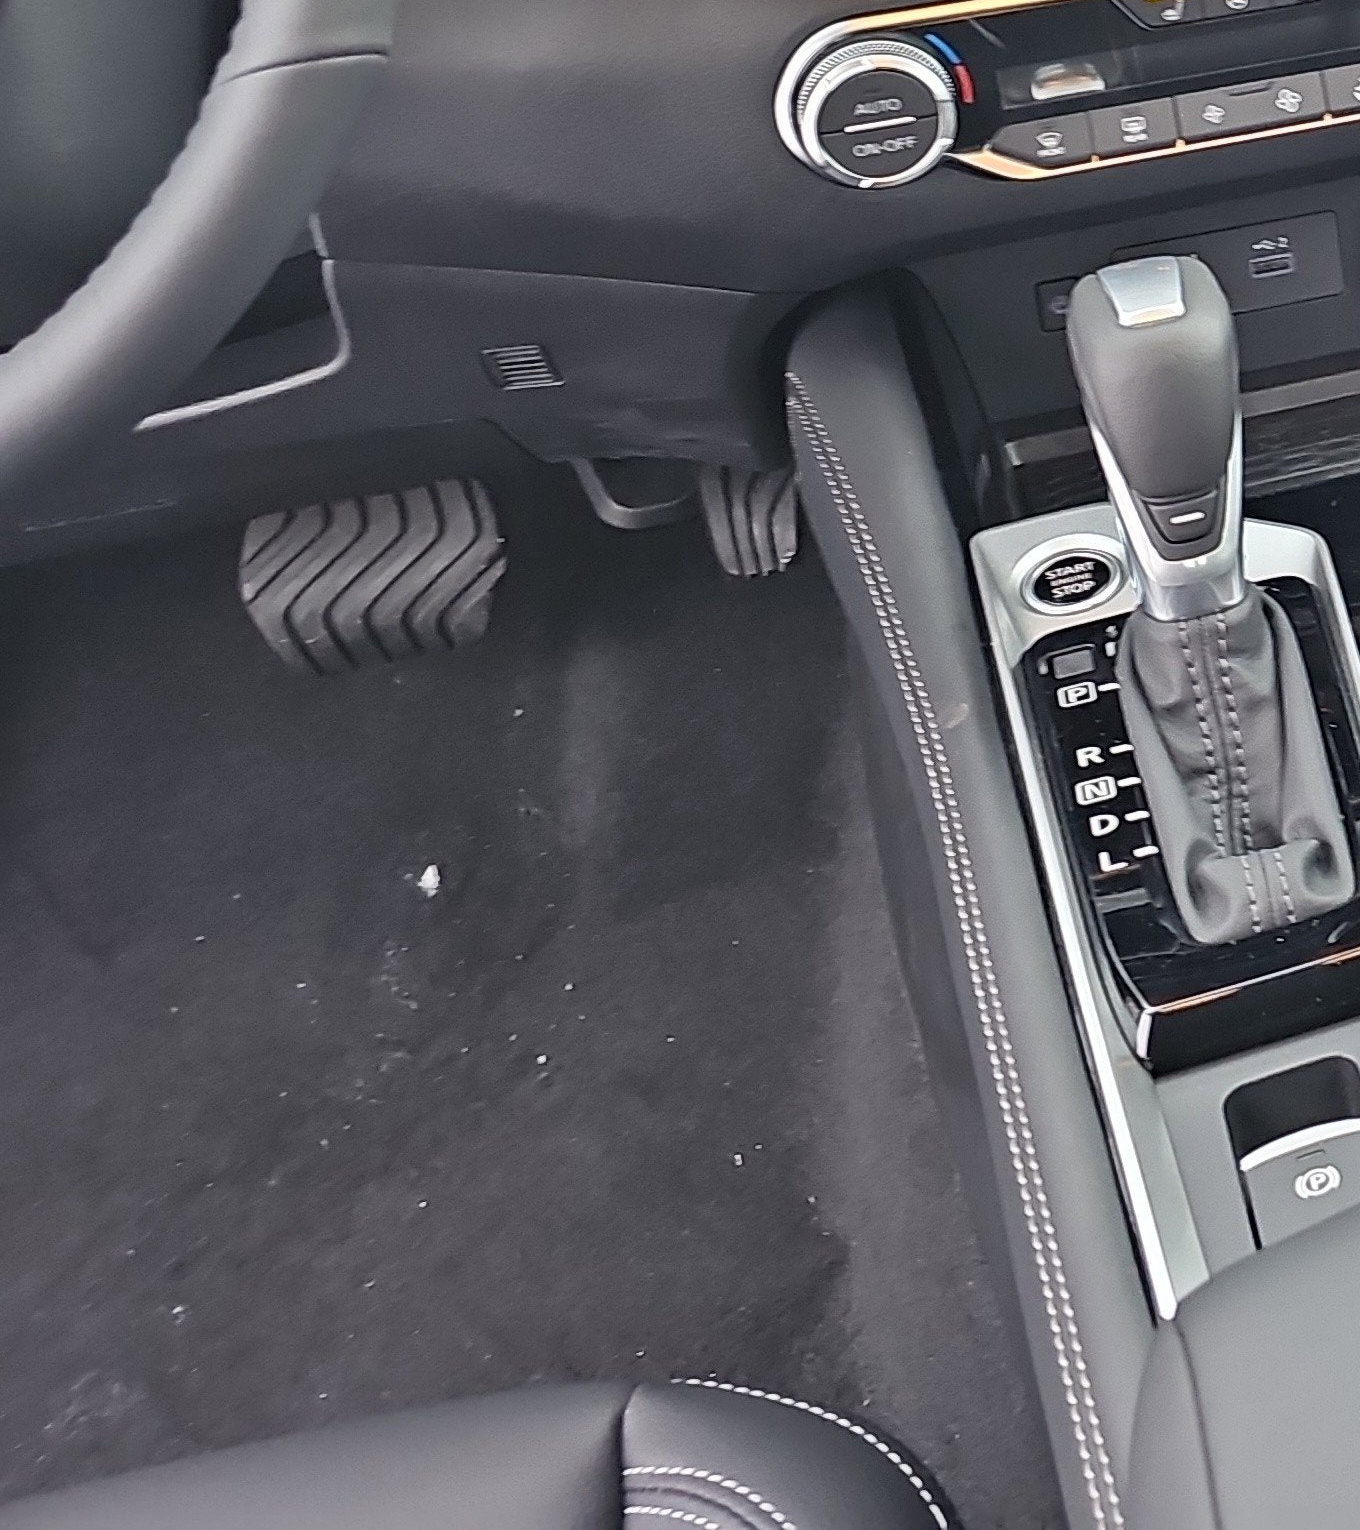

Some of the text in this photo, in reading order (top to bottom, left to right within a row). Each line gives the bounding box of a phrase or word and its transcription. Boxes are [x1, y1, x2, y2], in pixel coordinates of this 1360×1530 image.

[854, 98, 903, 116] AUTO
[1044, 561, 1097, 580] START
[1049, 572, 1093, 587] ENGINE
[1050, 580, 1097, 599] STOP
[1075, 746, 1105, 768] R
[1089, 814, 1120, 837] D
[1098, 851, 1129, 872] L
